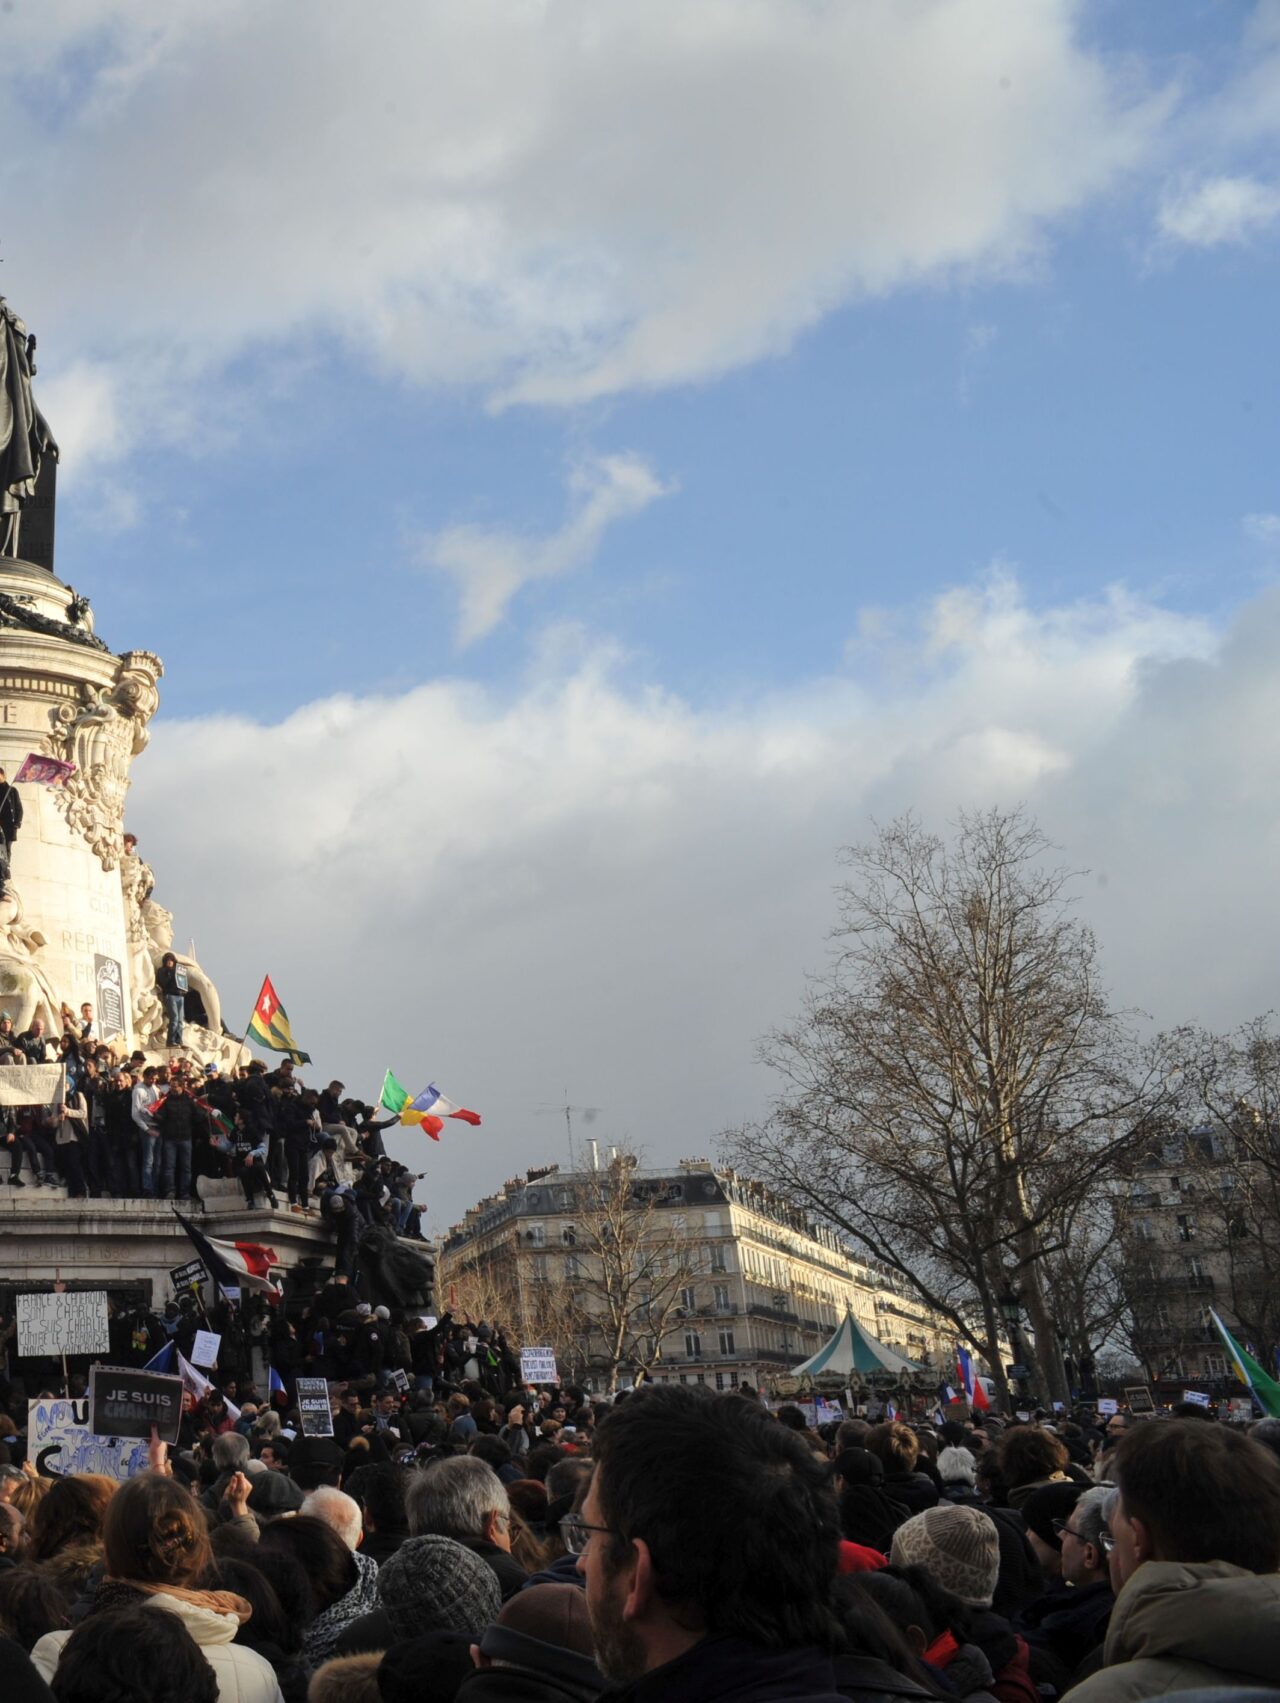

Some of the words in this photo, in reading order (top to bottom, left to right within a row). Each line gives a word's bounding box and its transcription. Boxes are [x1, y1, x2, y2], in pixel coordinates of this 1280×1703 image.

[34, 1246, 95, 1260] JUILLET
[17, 1293, 52, 1308] FRANCE
[56, 1295, 63, 1307] &
[65, 1291, 107, 1307] CAMEROUN
[57, 1303, 102, 1320] CHARLIE
[19, 1320, 32, 1335] JE
[39, 1319, 63, 1334] SUIS
[67, 1316, 108, 1334] CHARLIE
[18, 1332, 48, 1346] CONTRE
[52, 1332, 60, 1345] LE
[22, 1344, 46, 1356] NOUS
[58, 1342, 108, 1355] VAINCRONS
[106, 1390, 128, 1401] JE
[131, 1391, 172, 1407] SUIS
[103, 1402, 172, 1423] CHARLIE
